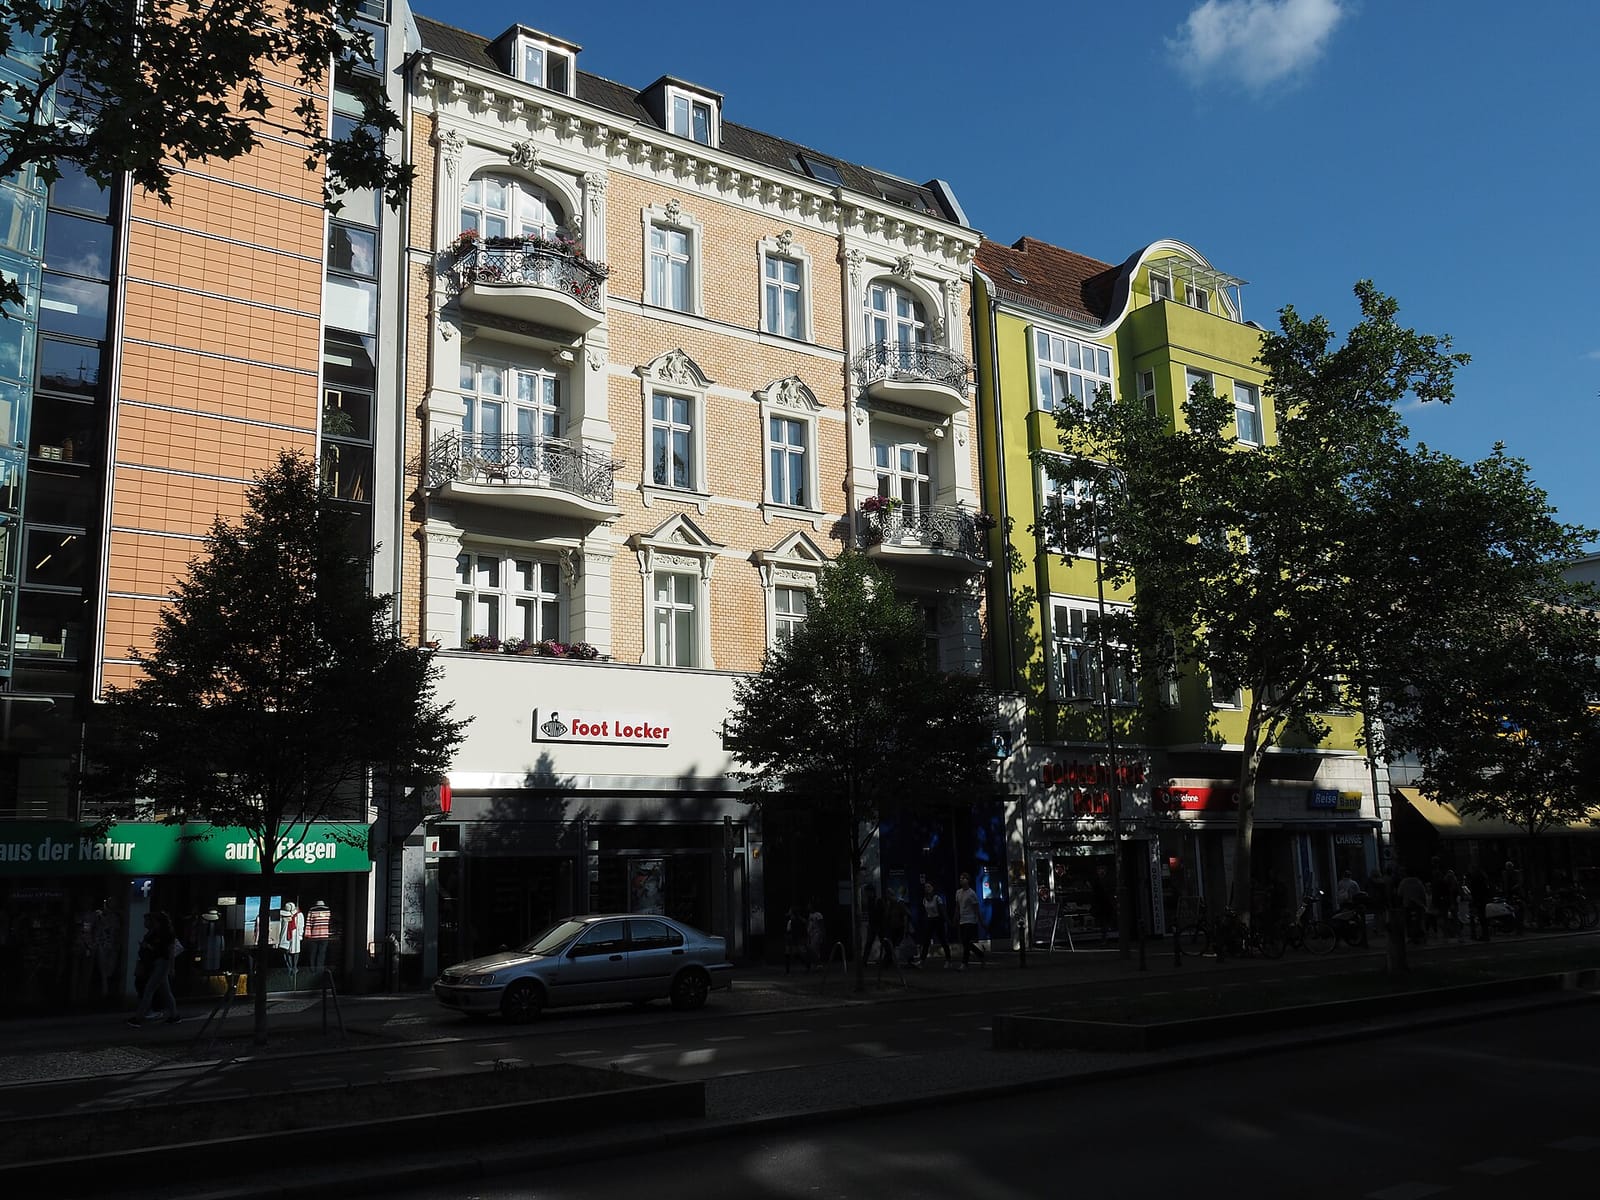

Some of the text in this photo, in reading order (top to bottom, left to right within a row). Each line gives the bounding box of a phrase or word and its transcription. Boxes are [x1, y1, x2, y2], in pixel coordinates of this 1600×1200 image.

[572, 718, 670, 739] Foot Locker
[1315, 793, 1337, 804] Reise
[37, 837, 74, 862] der
[78, 837, 136, 862] Natur
[225, 837, 257, 860] auf
[276, 837, 336, 864] Etagen
